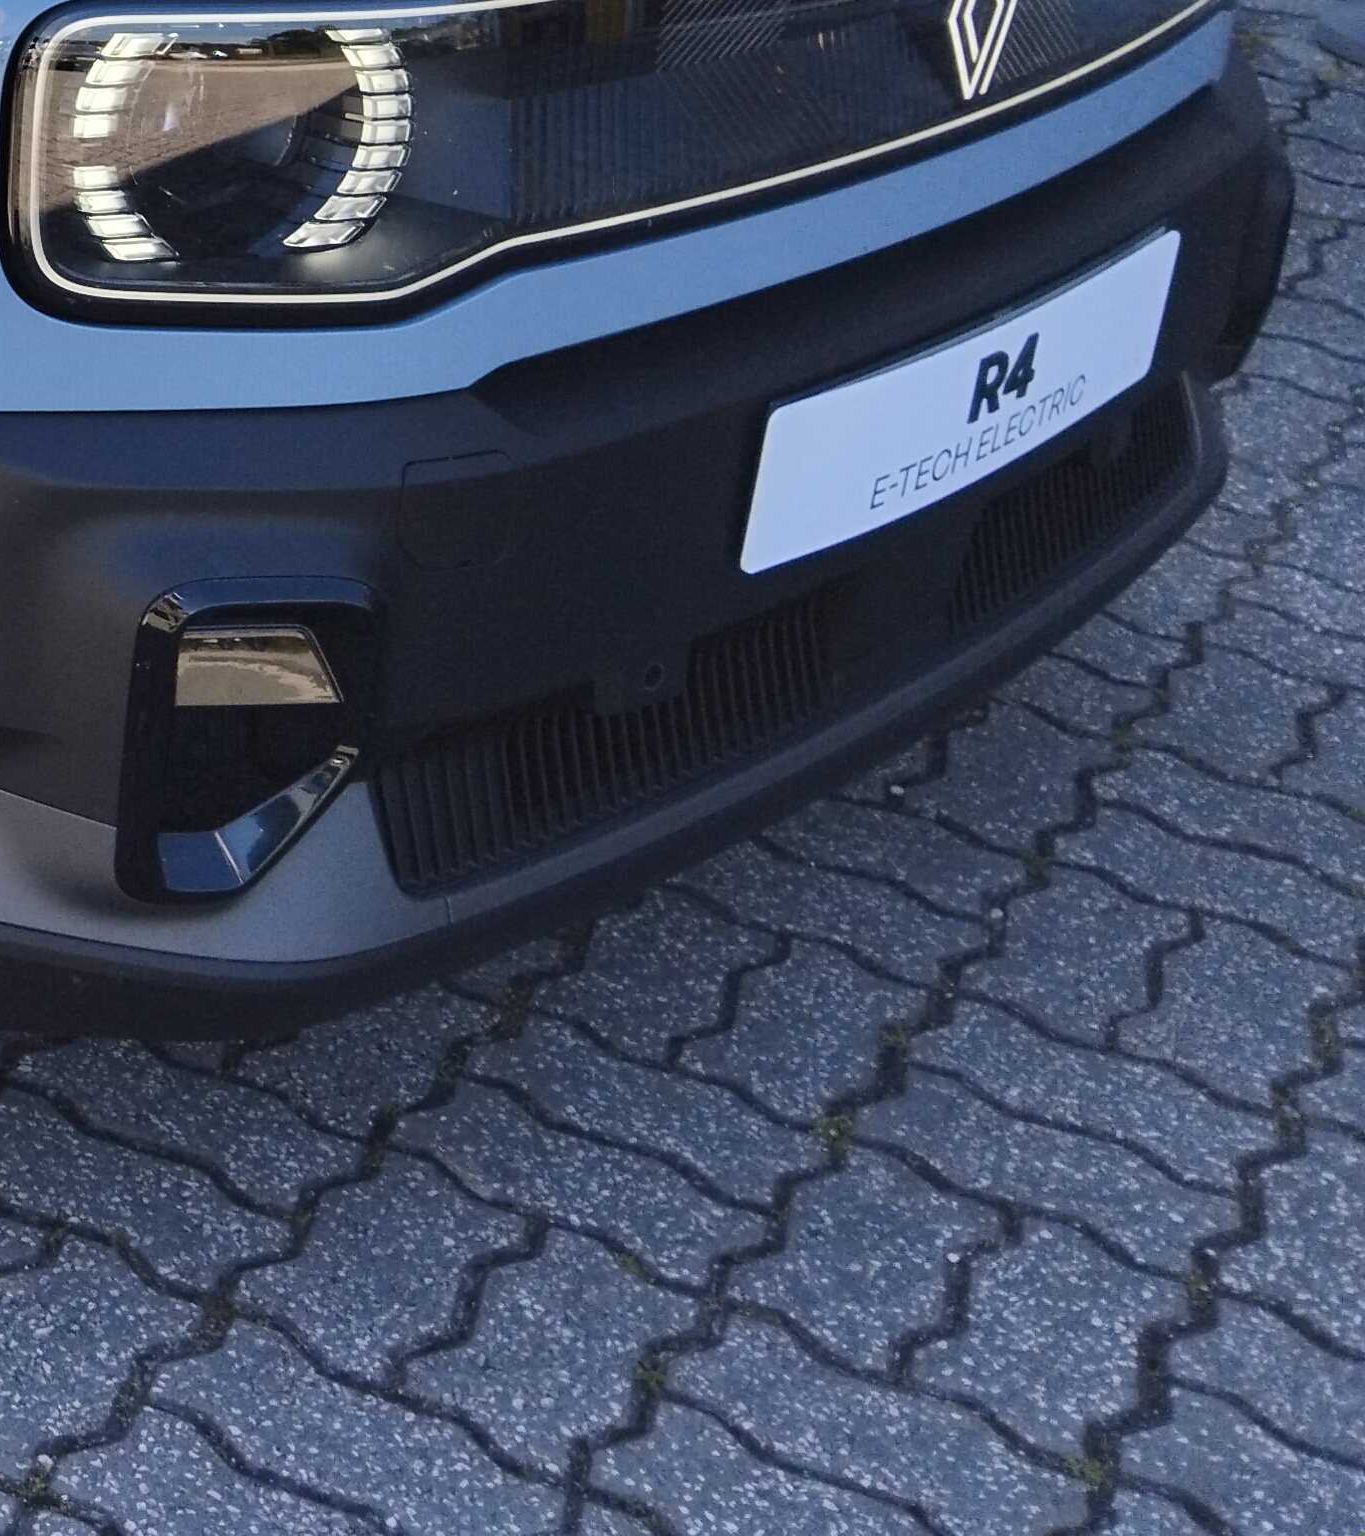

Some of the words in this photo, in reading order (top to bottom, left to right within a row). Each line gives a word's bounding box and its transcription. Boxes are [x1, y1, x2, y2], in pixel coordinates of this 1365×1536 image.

[966, 331, 1040, 425] R4
[870, 435, 972, 511] E-TECH
[975, 374, 1087, 463] ELECTRIC
